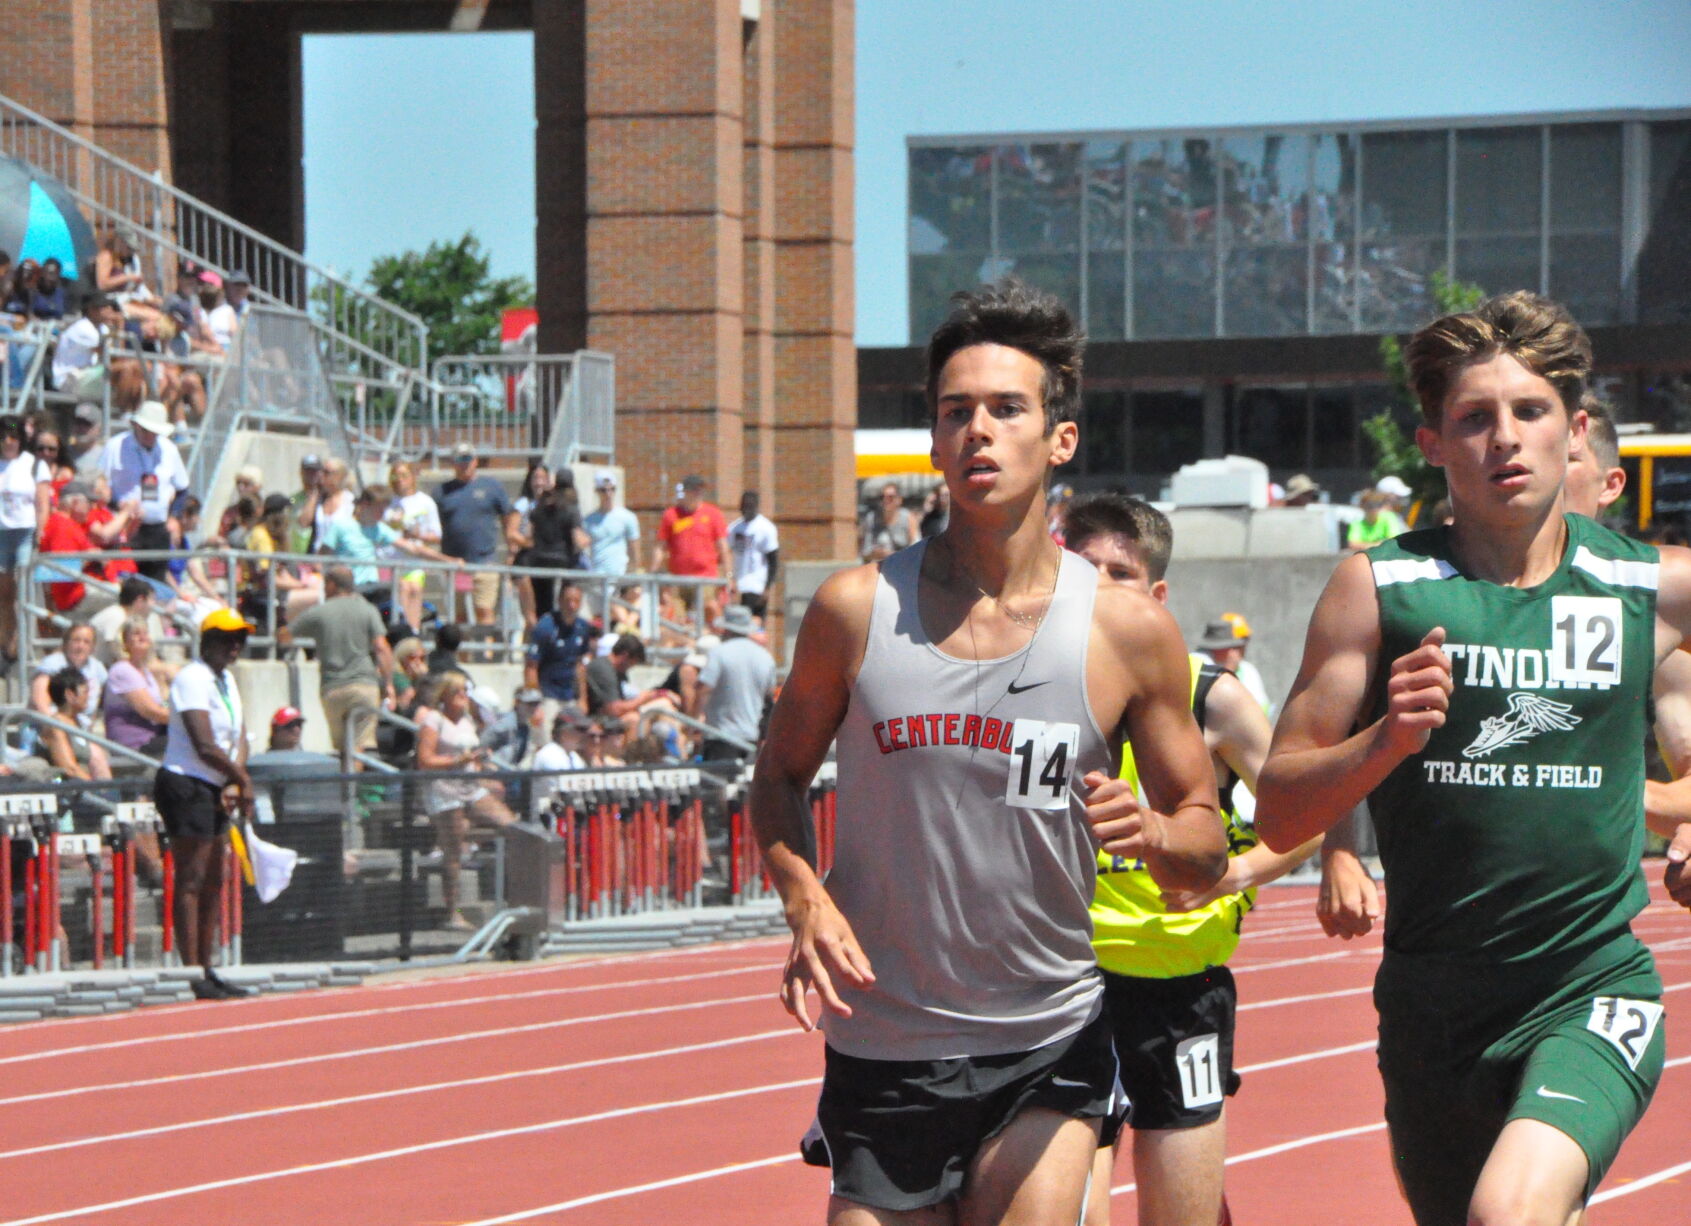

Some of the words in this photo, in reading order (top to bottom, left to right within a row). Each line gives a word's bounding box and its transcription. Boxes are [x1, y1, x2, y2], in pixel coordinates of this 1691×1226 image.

[1556, 614, 1615, 673] 12
[1014, 738, 1068, 798] 14
[1423, 761, 1506, 787] TRACK
[1512, 764, 1529, 787] &
[1535, 765, 1603, 788] FIELD
[1598, 997, 1648, 1060] 12
[1181, 1049, 1212, 1098] 11
